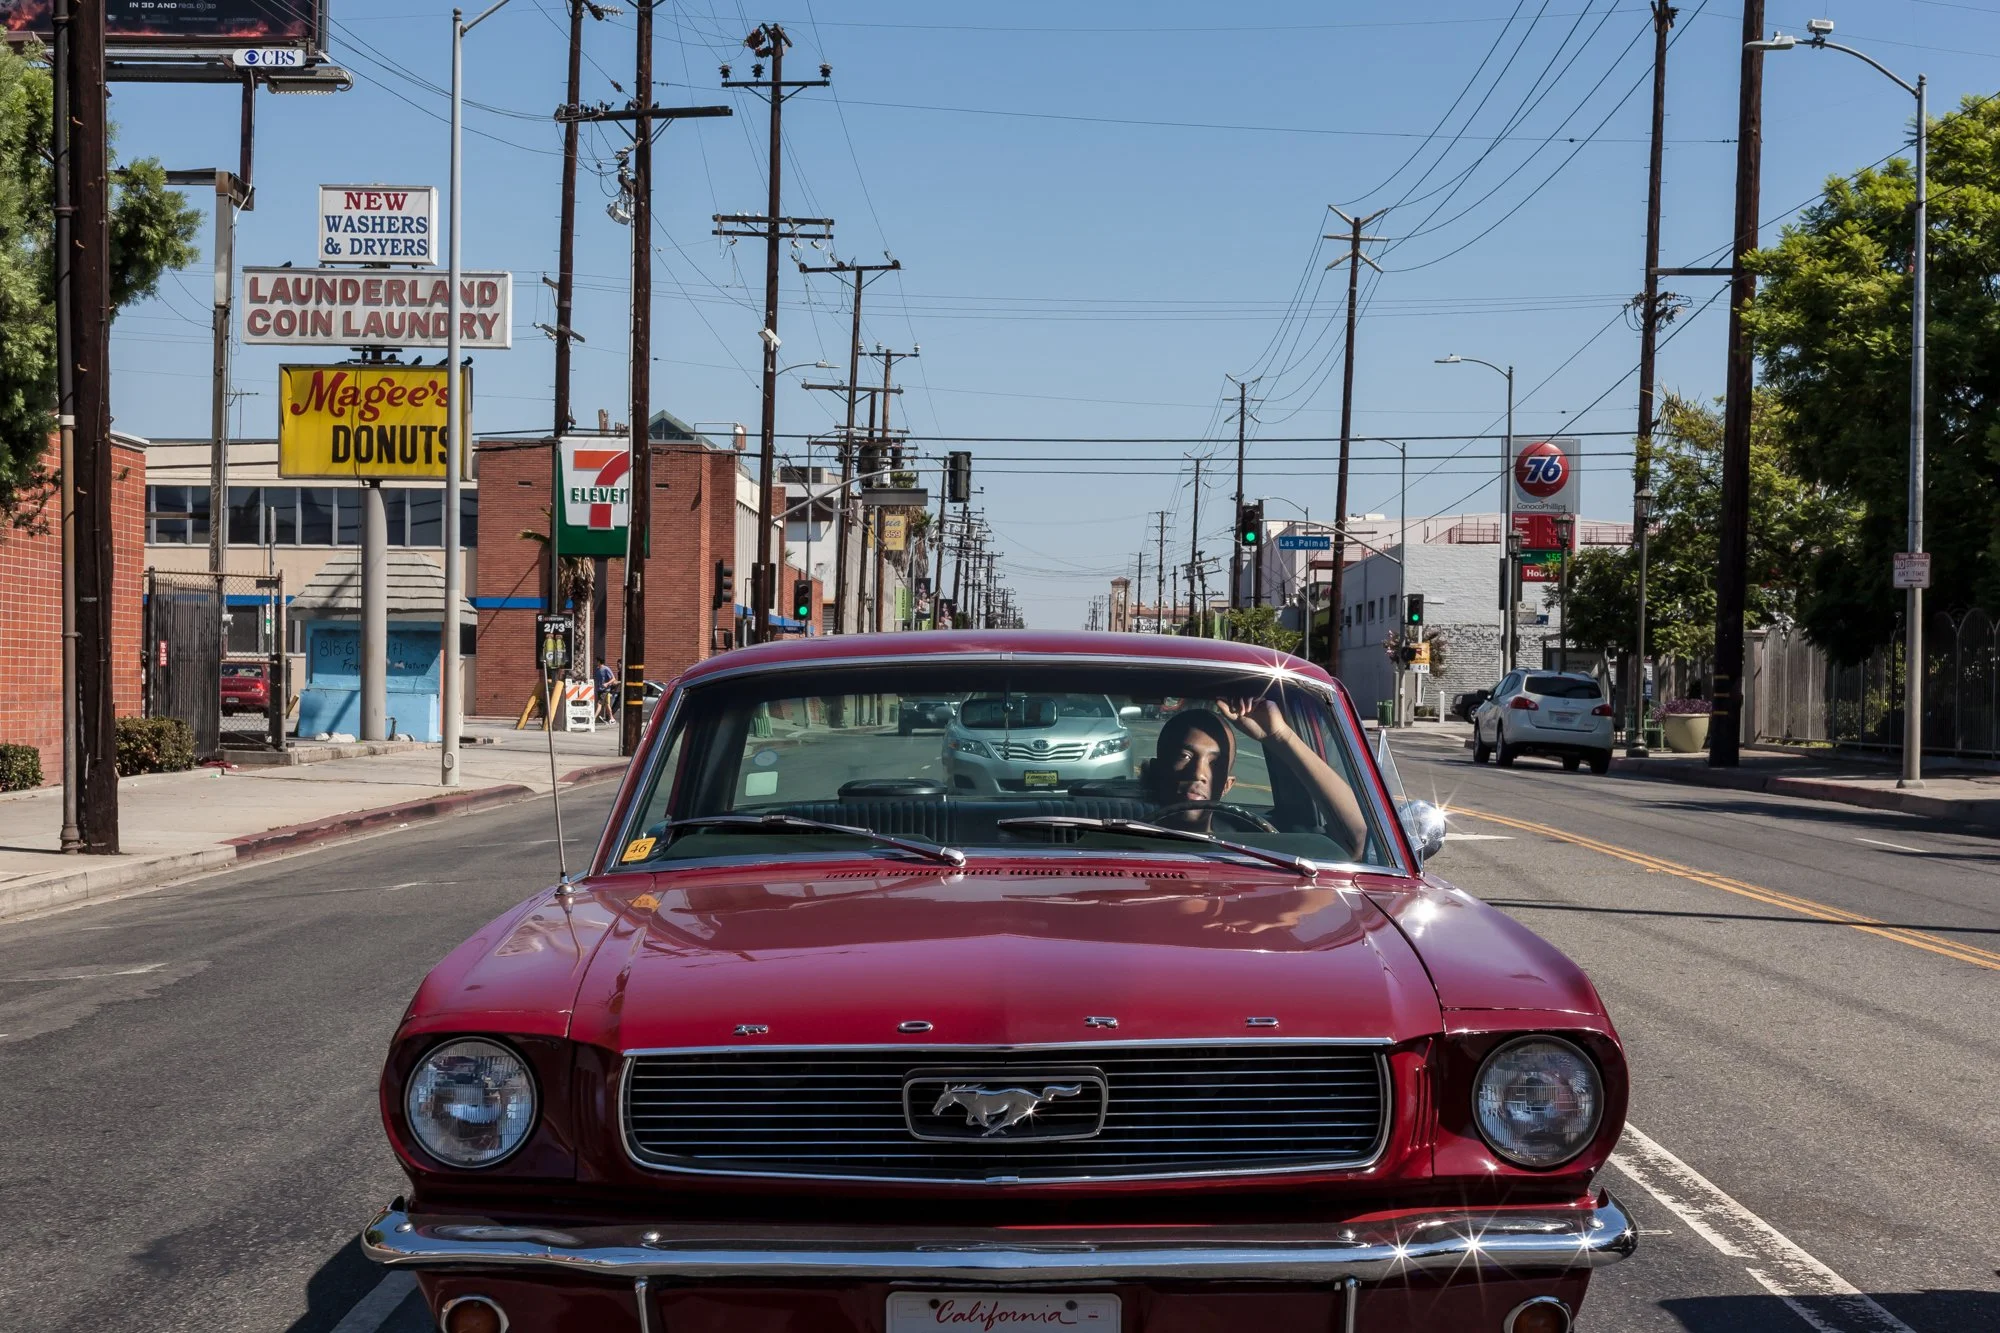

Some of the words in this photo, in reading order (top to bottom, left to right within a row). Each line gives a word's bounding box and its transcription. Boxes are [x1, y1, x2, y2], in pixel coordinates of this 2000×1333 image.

[262, 50, 296, 65] CBS
[344, 191, 408, 211] NEW
[324, 215, 428, 234] WASHERS
[324, 237, 342, 255] &
[349, 238, 428, 256] DRYERS
[249, 276, 499, 308] LAUNDERLAND
[247, 308, 334, 337] COIN
[342, 310, 500, 339] LAUNDRY
[290, 369, 448, 422] Magee's
[332, 425, 448, 464] DONUTS
[1524, 455, 1562, 484] 76
[573, 449, 630, 528] 7
[1280, 539, 1294, 547] Las
[1298, 539, 1329, 547] Palmas
[1526, 569, 1554, 578] Hous
[1895, 560, 1905, 569] NO
[936, 1299, 1076, 1332] California
